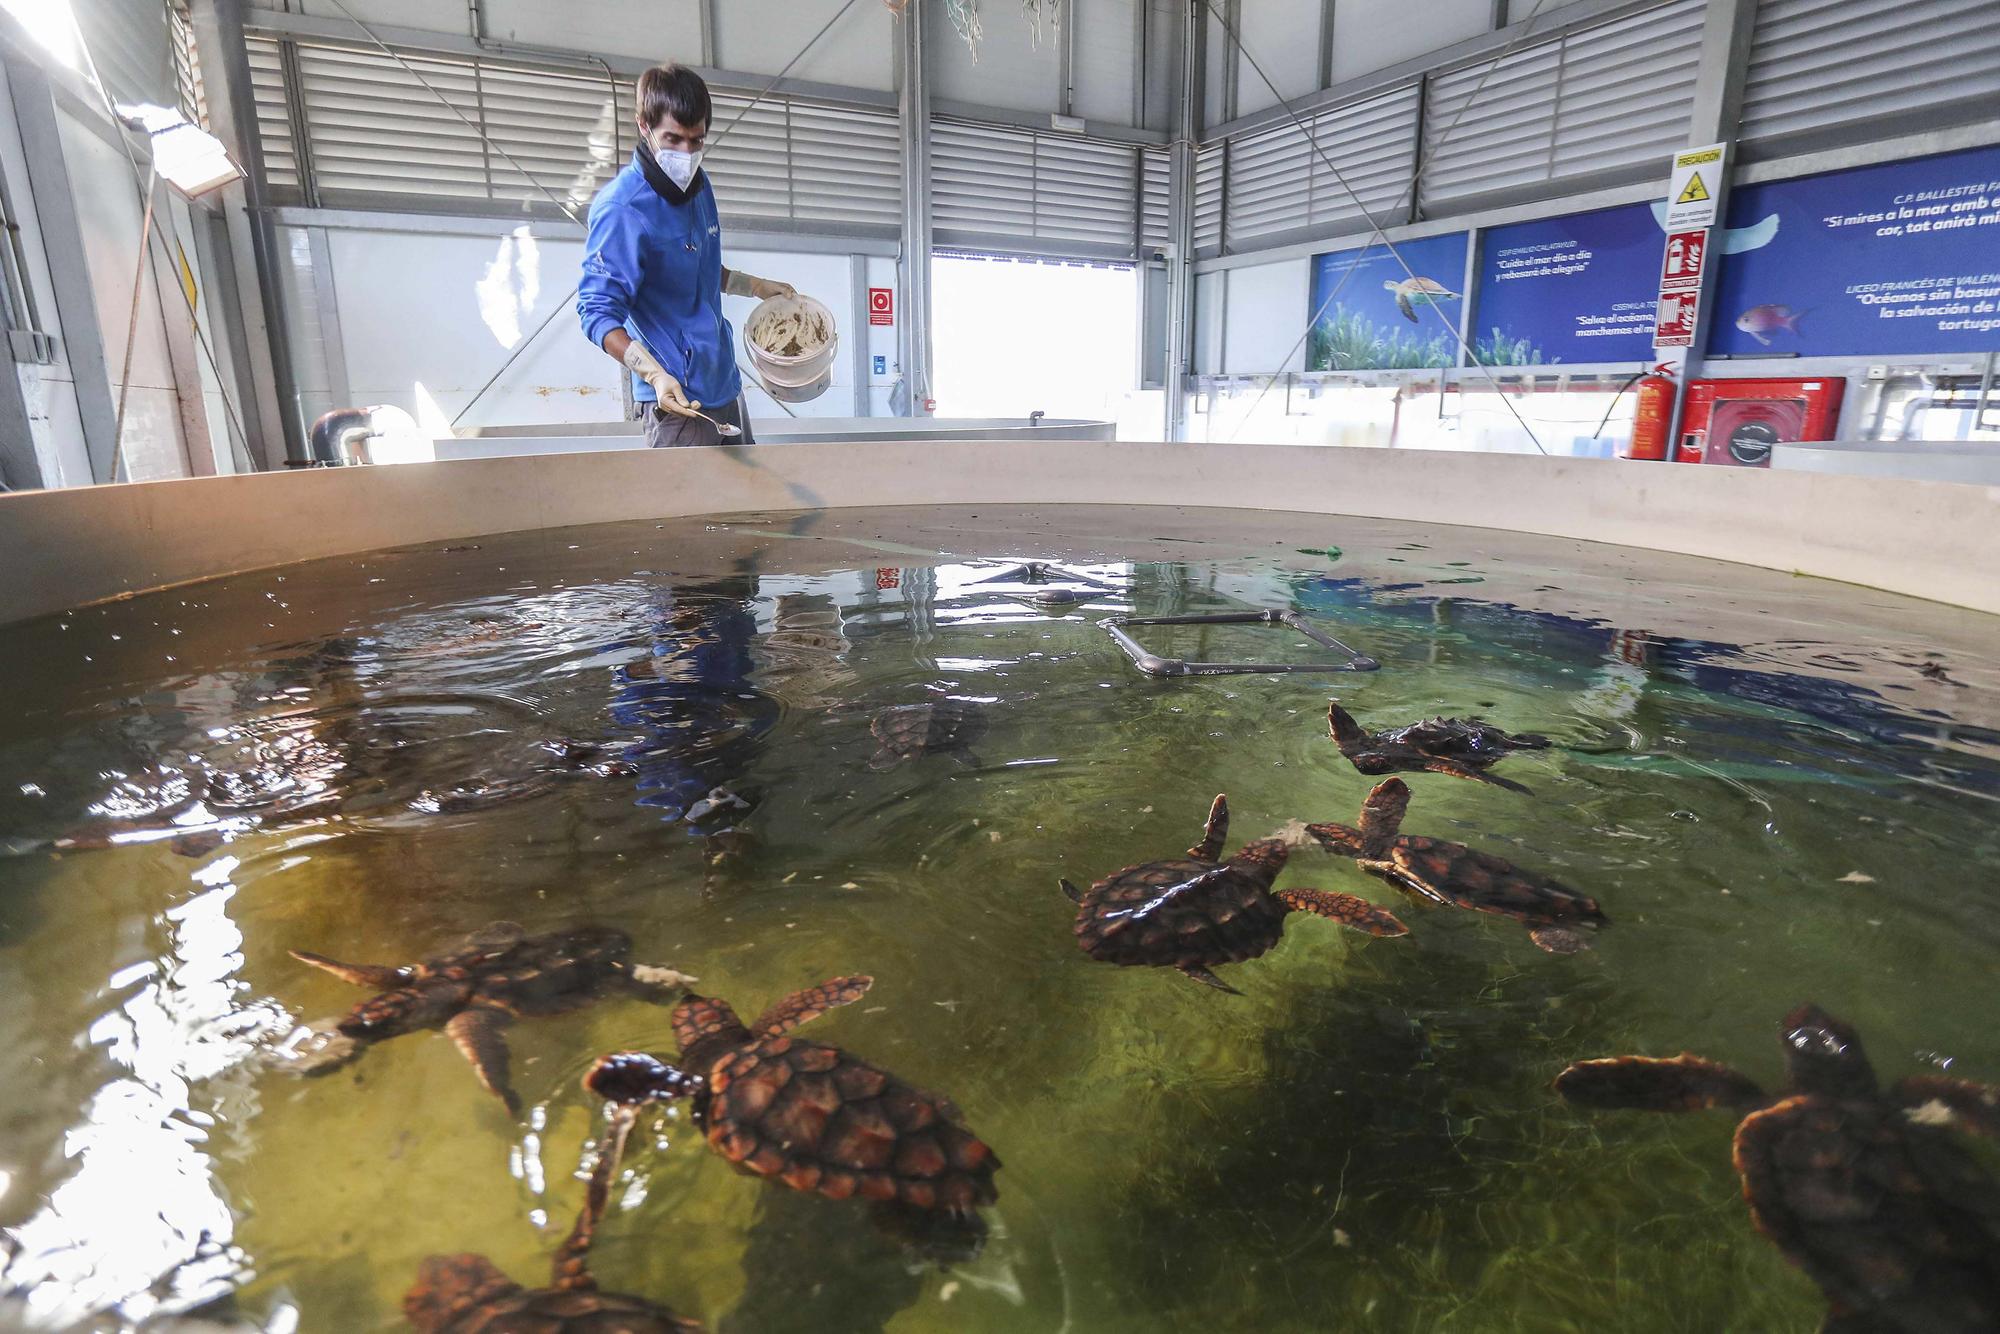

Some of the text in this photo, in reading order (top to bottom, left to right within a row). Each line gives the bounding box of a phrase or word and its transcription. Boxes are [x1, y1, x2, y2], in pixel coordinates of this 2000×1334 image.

[1893, 194, 1913, 204] C.P.
[1915, 183, 1986, 202] BALLESTER
[1844, 212, 1885, 226] mires
[1885, 212, 1896, 221] a
[1898, 207, 1914, 219] la
[1916, 204, 1949, 217] mar
[1951, 196, 1989, 213] amb
[1876, 225, 1904, 237] cor,
[1906, 220, 1932, 233] tot
[1933, 213, 1976, 230] anirà
[1525, 256, 1534, 266] el
[1552, 253, 1568, 263] día
[1576, 249, 1592, 260] día
[1540, 266, 1552, 276] de
[1845, 283, 1879, 294] LICEO
[1880, 278, 1935, 291] FRANCÉS
[1936, 277, 1956, 287] DE
[1928, 288, 1952, 300] sin
[1879, 307, 1895, 318] la
[1896, 302, 1971, 318] salvación
[1972, 300, 1995, 313] de
[1607, 313, 1617, 323] el
[1633, 324, 1644, 334] el
